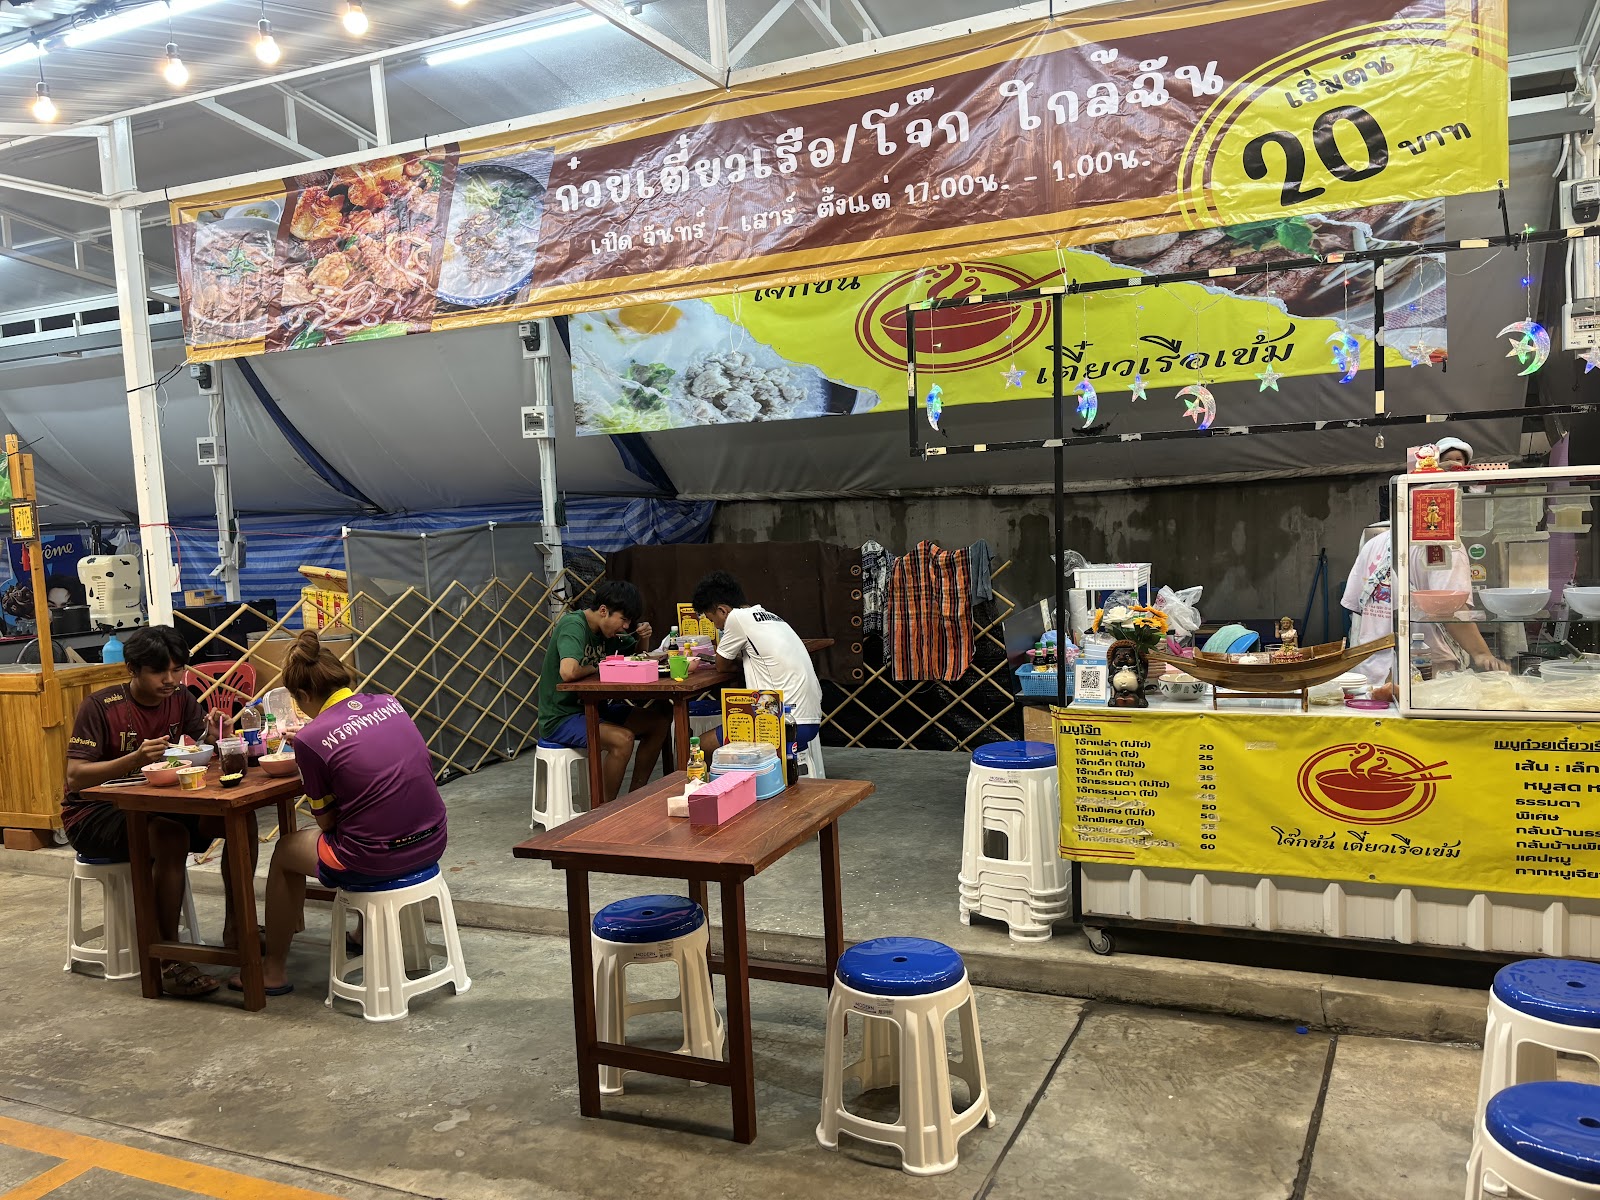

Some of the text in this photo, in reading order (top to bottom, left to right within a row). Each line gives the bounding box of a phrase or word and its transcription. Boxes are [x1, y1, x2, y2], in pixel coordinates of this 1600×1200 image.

[1284, 52, 1395, 110] เริ่มต้น
[556, 48, 1224, 212] ก๋วยเตี๋ยวเรือ/โจ๊ก ใกล้ฉัน
[1242, 104, 1473, 207] 20 บาท
[591, 231, 633, 256] เปิด
[642, 211, 705, 248] จันทร์
[740, 192, 797, 233] เสาร์
[816, 174, 892, 221] ตั้งแต่
[905, 169, 1010, 206] 17.00น.
[1052, 149, 1152, 183] 1.00น.
[1036, 322, 1296, 385] เตี๋ยวเรือเข้ม
[1059, 724, 1102, 736] เมนูโจ๊ก
[1515, 759, 1549, 772] เส้น
[1565, 761, 1600, 773] เล็ก
[1524, 781, 1581, 795] หมูสด
[1515, 798, 1581, 808] ธรรมดา
[1515, 811, 1560, 821] พิเศษ
[1270, 825, 1462, 858] โจ๊กข้น เตี๋ยวเรือเข้ม
[1515, 853, 1572, 866] แคปหมู
